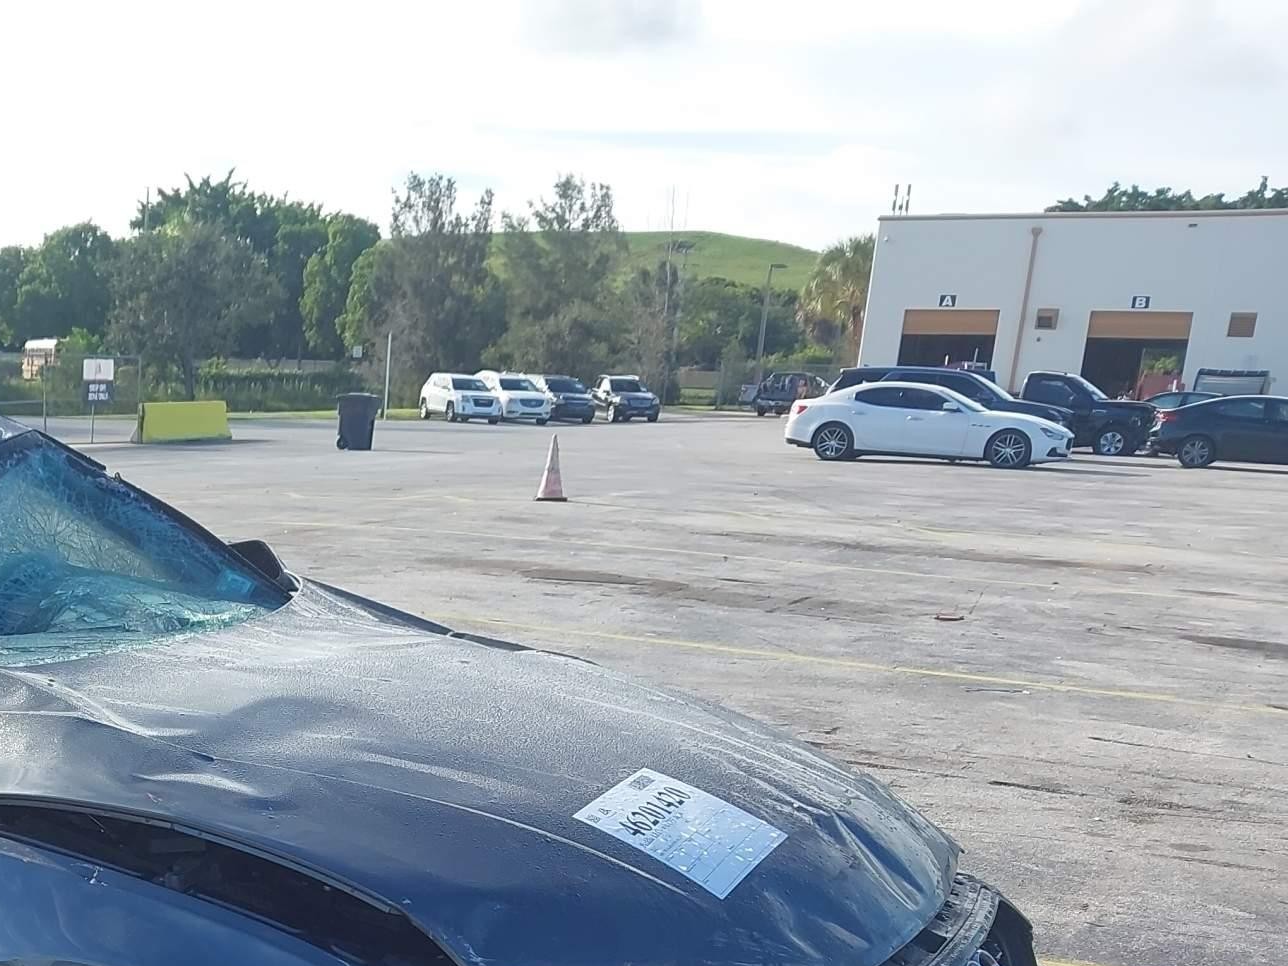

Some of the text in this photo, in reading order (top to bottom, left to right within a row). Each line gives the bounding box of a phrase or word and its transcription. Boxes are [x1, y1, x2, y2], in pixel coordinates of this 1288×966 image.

[941, 295, 953, 306] A
[1134, 297, 1147, 308] B
[618, 786, 692, 837] 46201420
